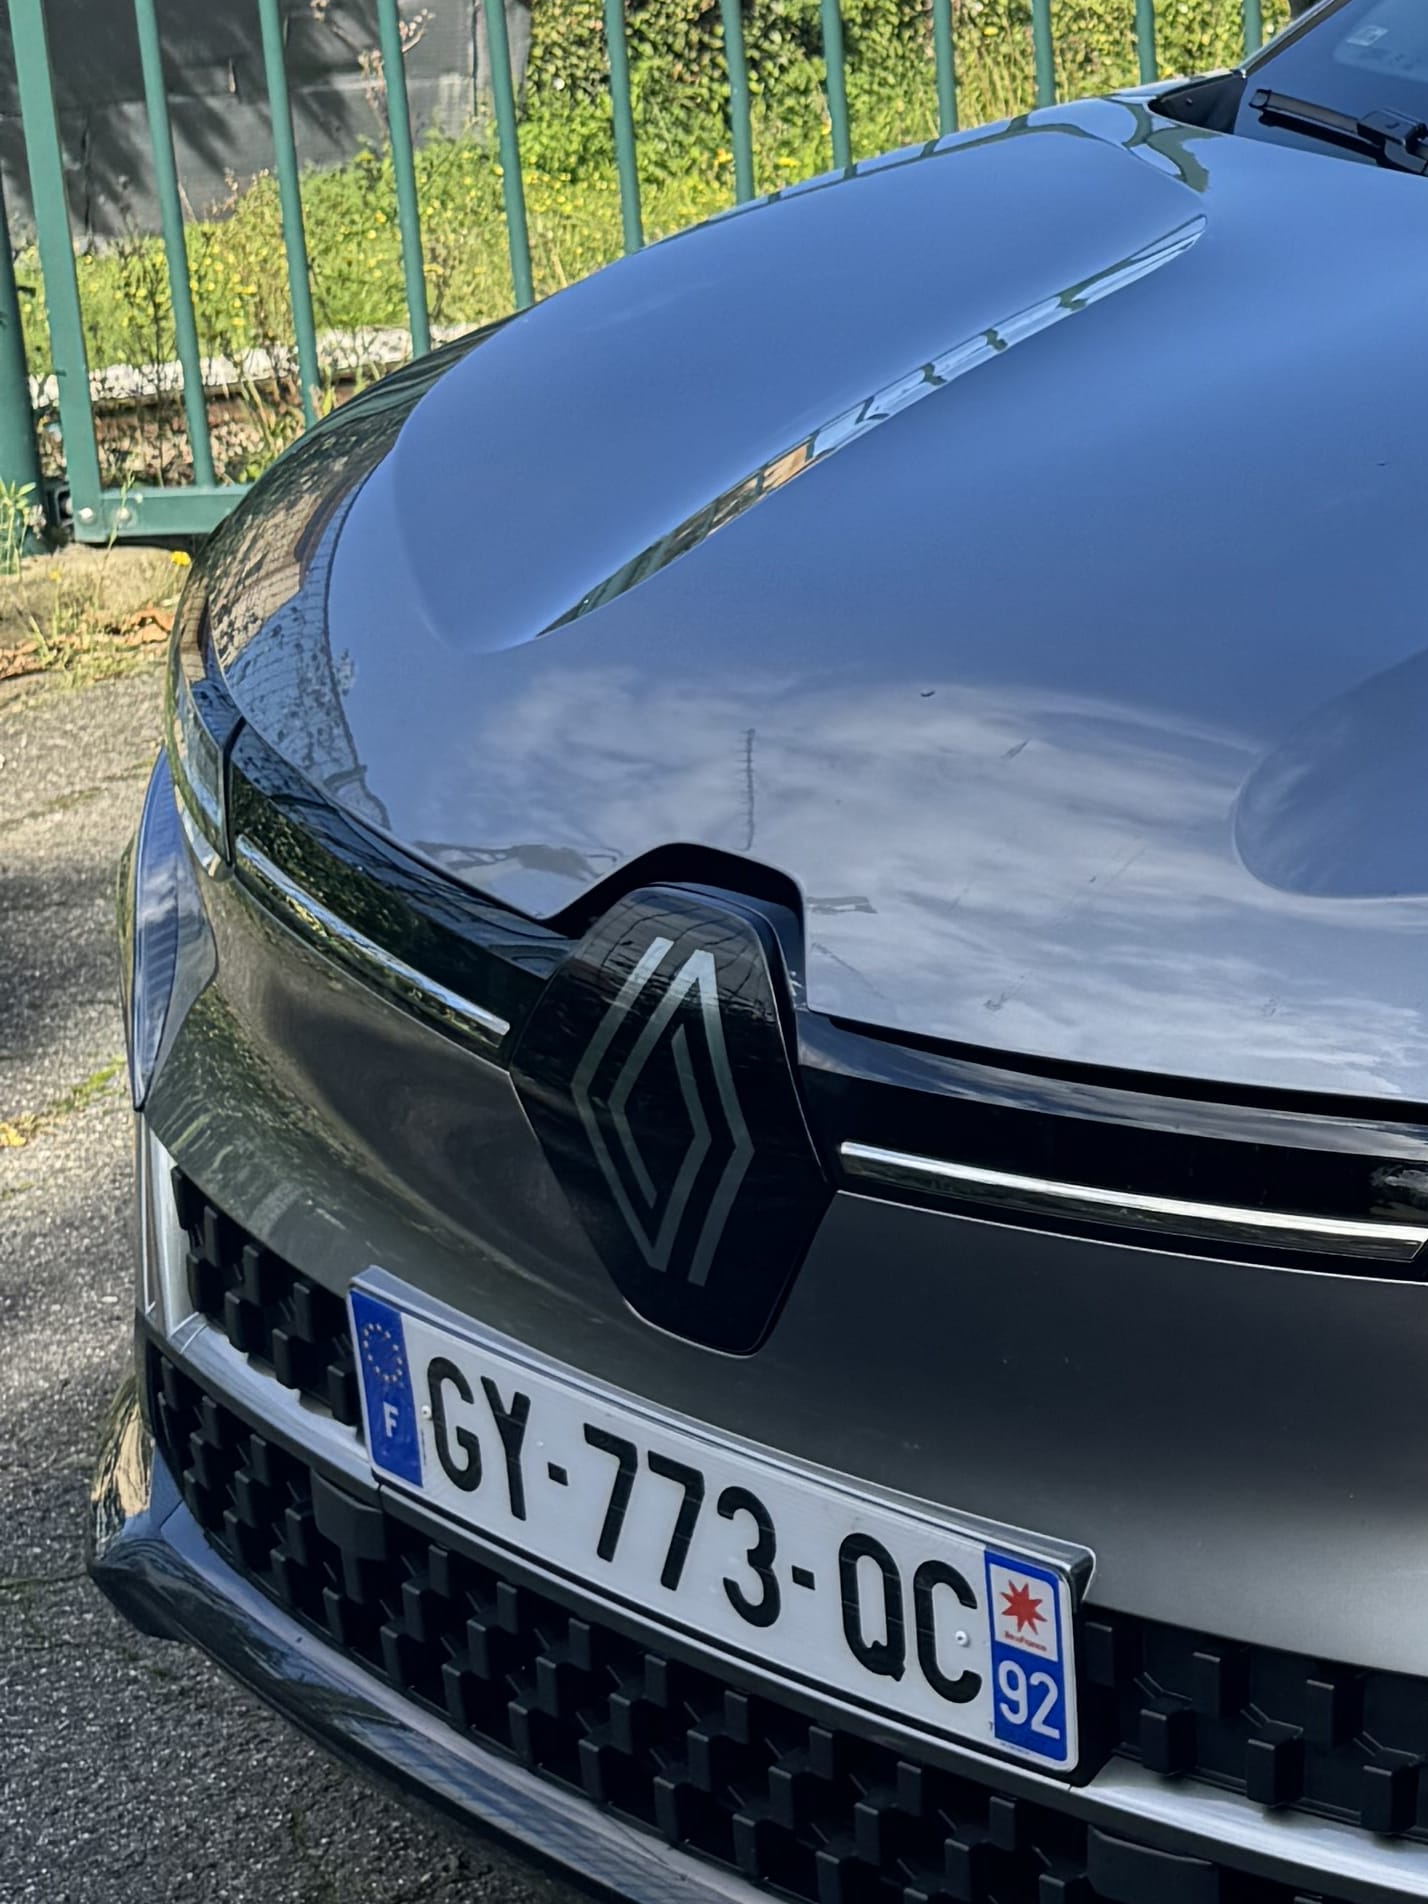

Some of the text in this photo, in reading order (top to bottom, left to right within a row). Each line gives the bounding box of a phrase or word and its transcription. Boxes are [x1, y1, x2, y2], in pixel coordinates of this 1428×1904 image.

[383, 1401, 399, 1438] F
[427, 1356, 982, 1704] GY-773-QC
[998, 1659, 1060, 1740] 92
